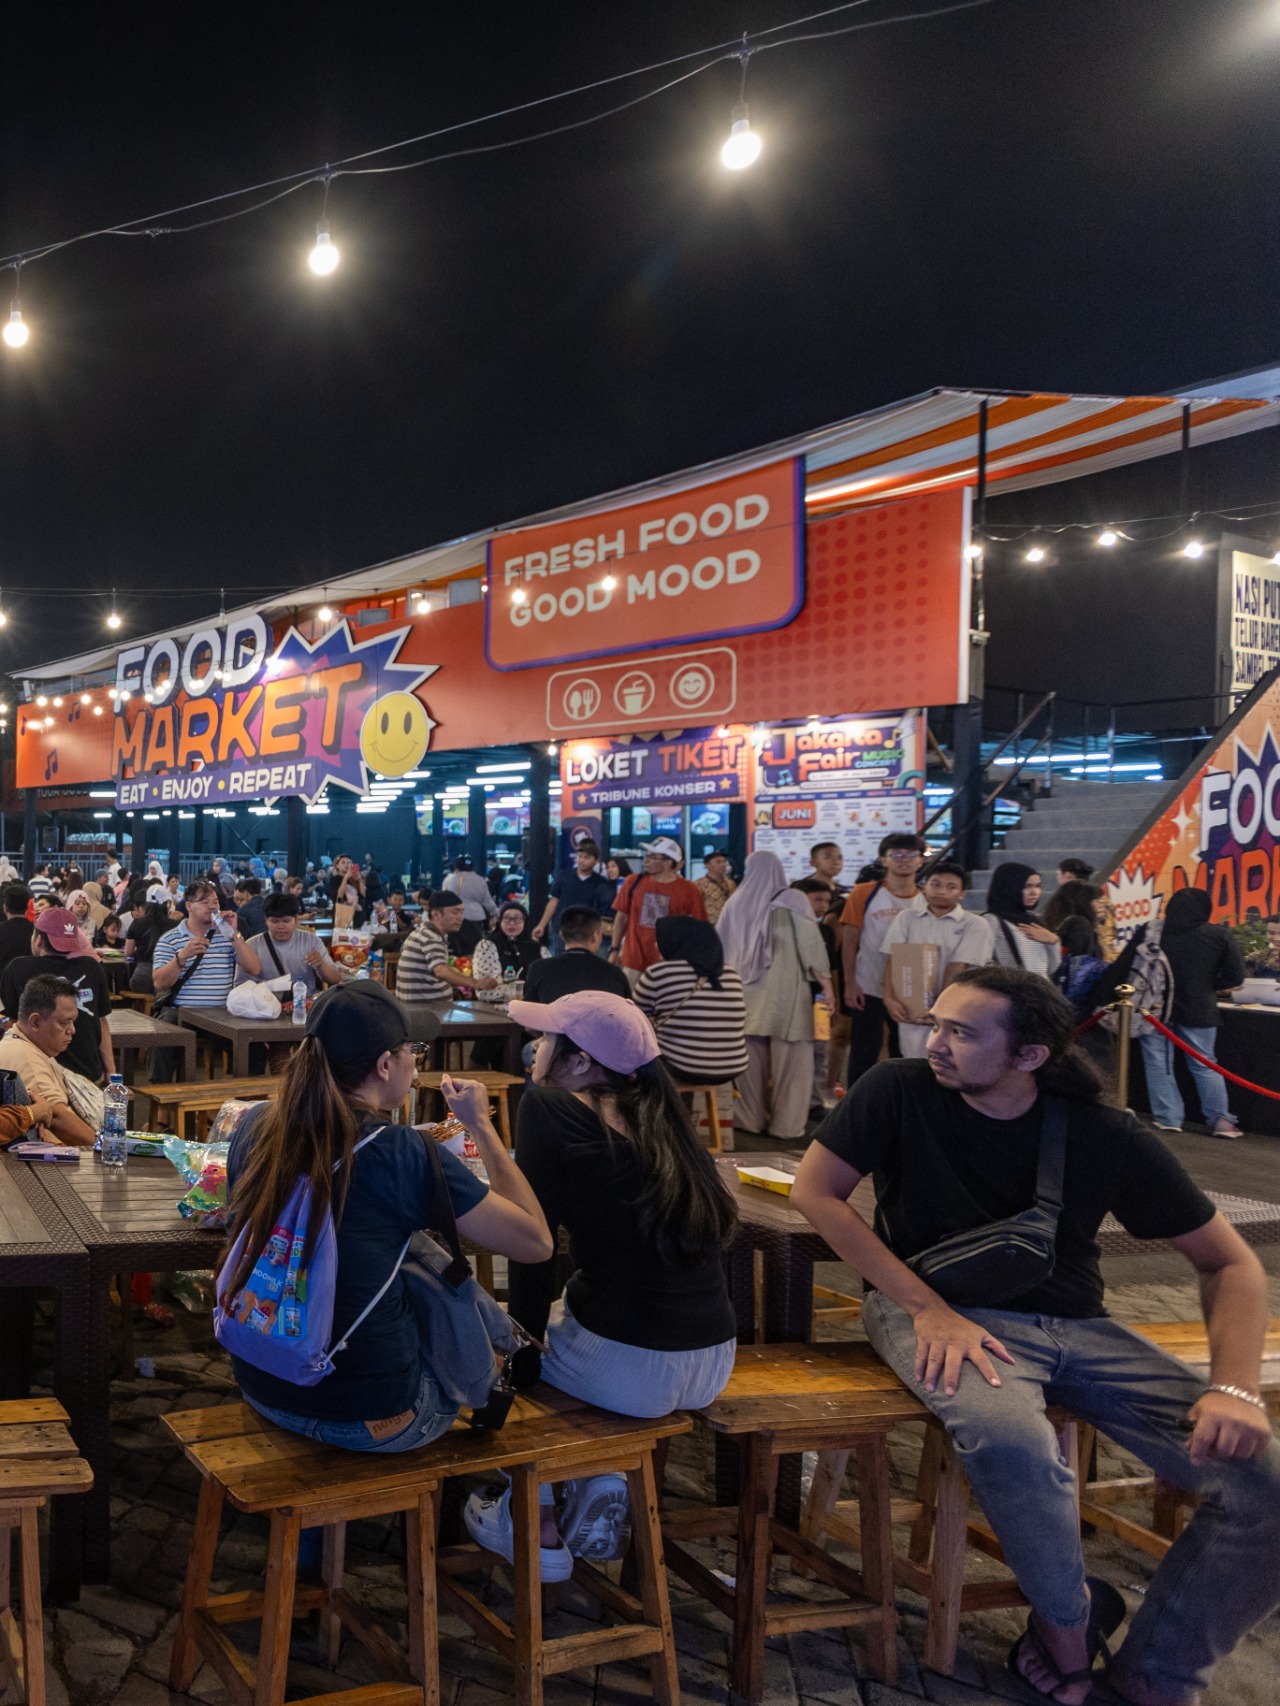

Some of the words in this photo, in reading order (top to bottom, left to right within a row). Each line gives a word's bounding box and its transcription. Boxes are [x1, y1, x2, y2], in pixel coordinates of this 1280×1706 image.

[504, 529, 625, 586] FRESH
[638, 494, 770, 552] FOOD
[509, 581, 615, 627] GOOD
[627, 549, 762, 605] MOOD
[1235, 573, 1261, 616] NASI
[114, 613, 271, 714] FOOD
[111, 662, 363, 778] MARKET
[566, 749, 649, 785] LOKET
[658, 735, 744, 773] TIKET
[798, 747, 861, 782] Fair
[120, 782, 147, 805] EAT
[161, 773, 214, 800] ENJOY
[229, 763, 313, 794] REPEAT
[591, 787, 651, 804] TRIBUNE
[654, 781, 716, 798] KONSER
[778, 808, 812, 821] JUNI
[1115, 899, 1151, 922] GOOD
